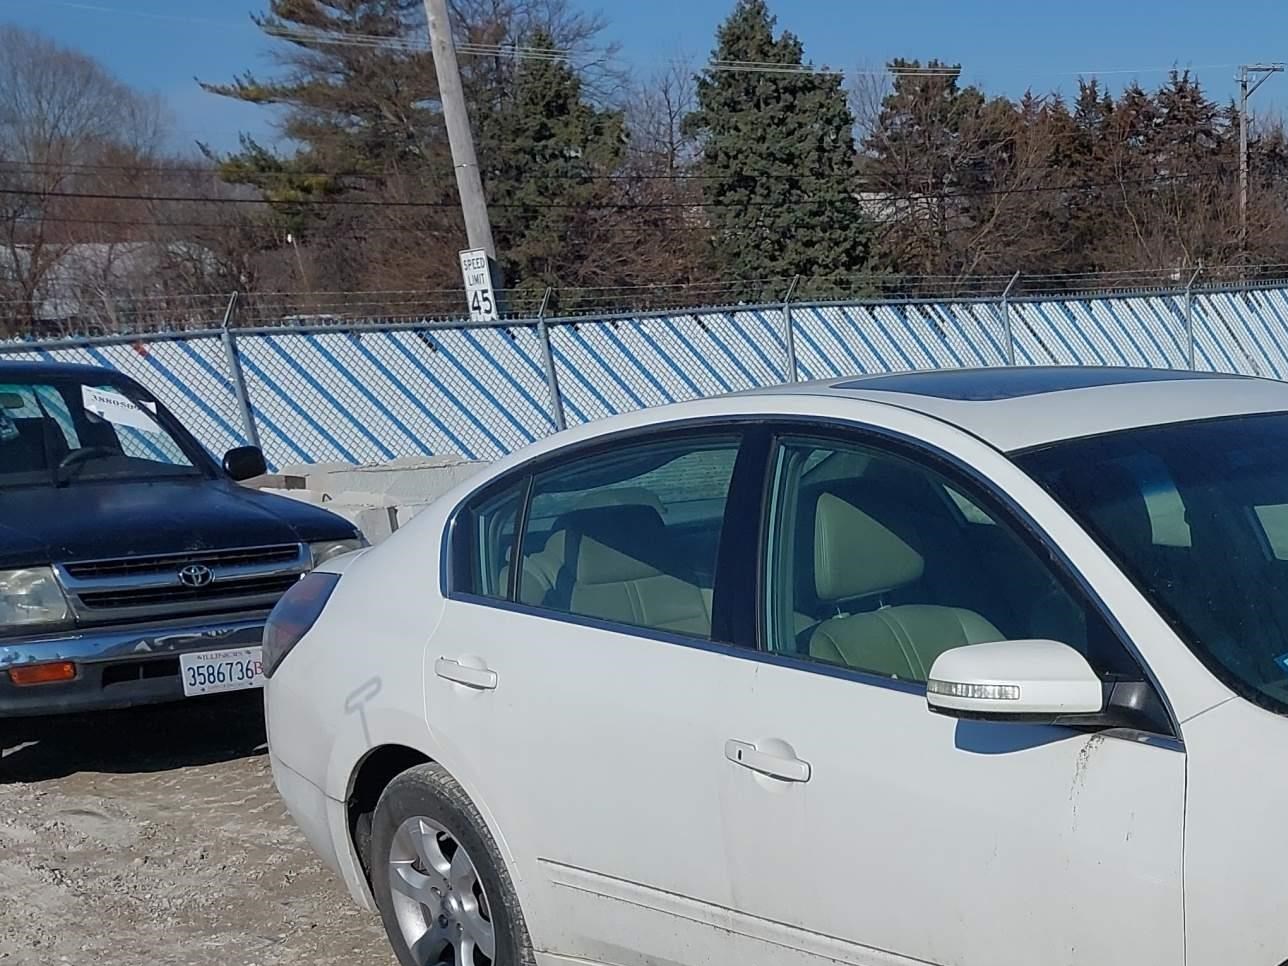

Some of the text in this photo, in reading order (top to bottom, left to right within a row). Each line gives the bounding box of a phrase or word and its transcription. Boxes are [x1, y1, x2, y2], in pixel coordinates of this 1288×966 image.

[463, 257, 486, 271] SPEED
[467, 273, 486, 286] LIMIT
[471, 289, 492, 315] 45
